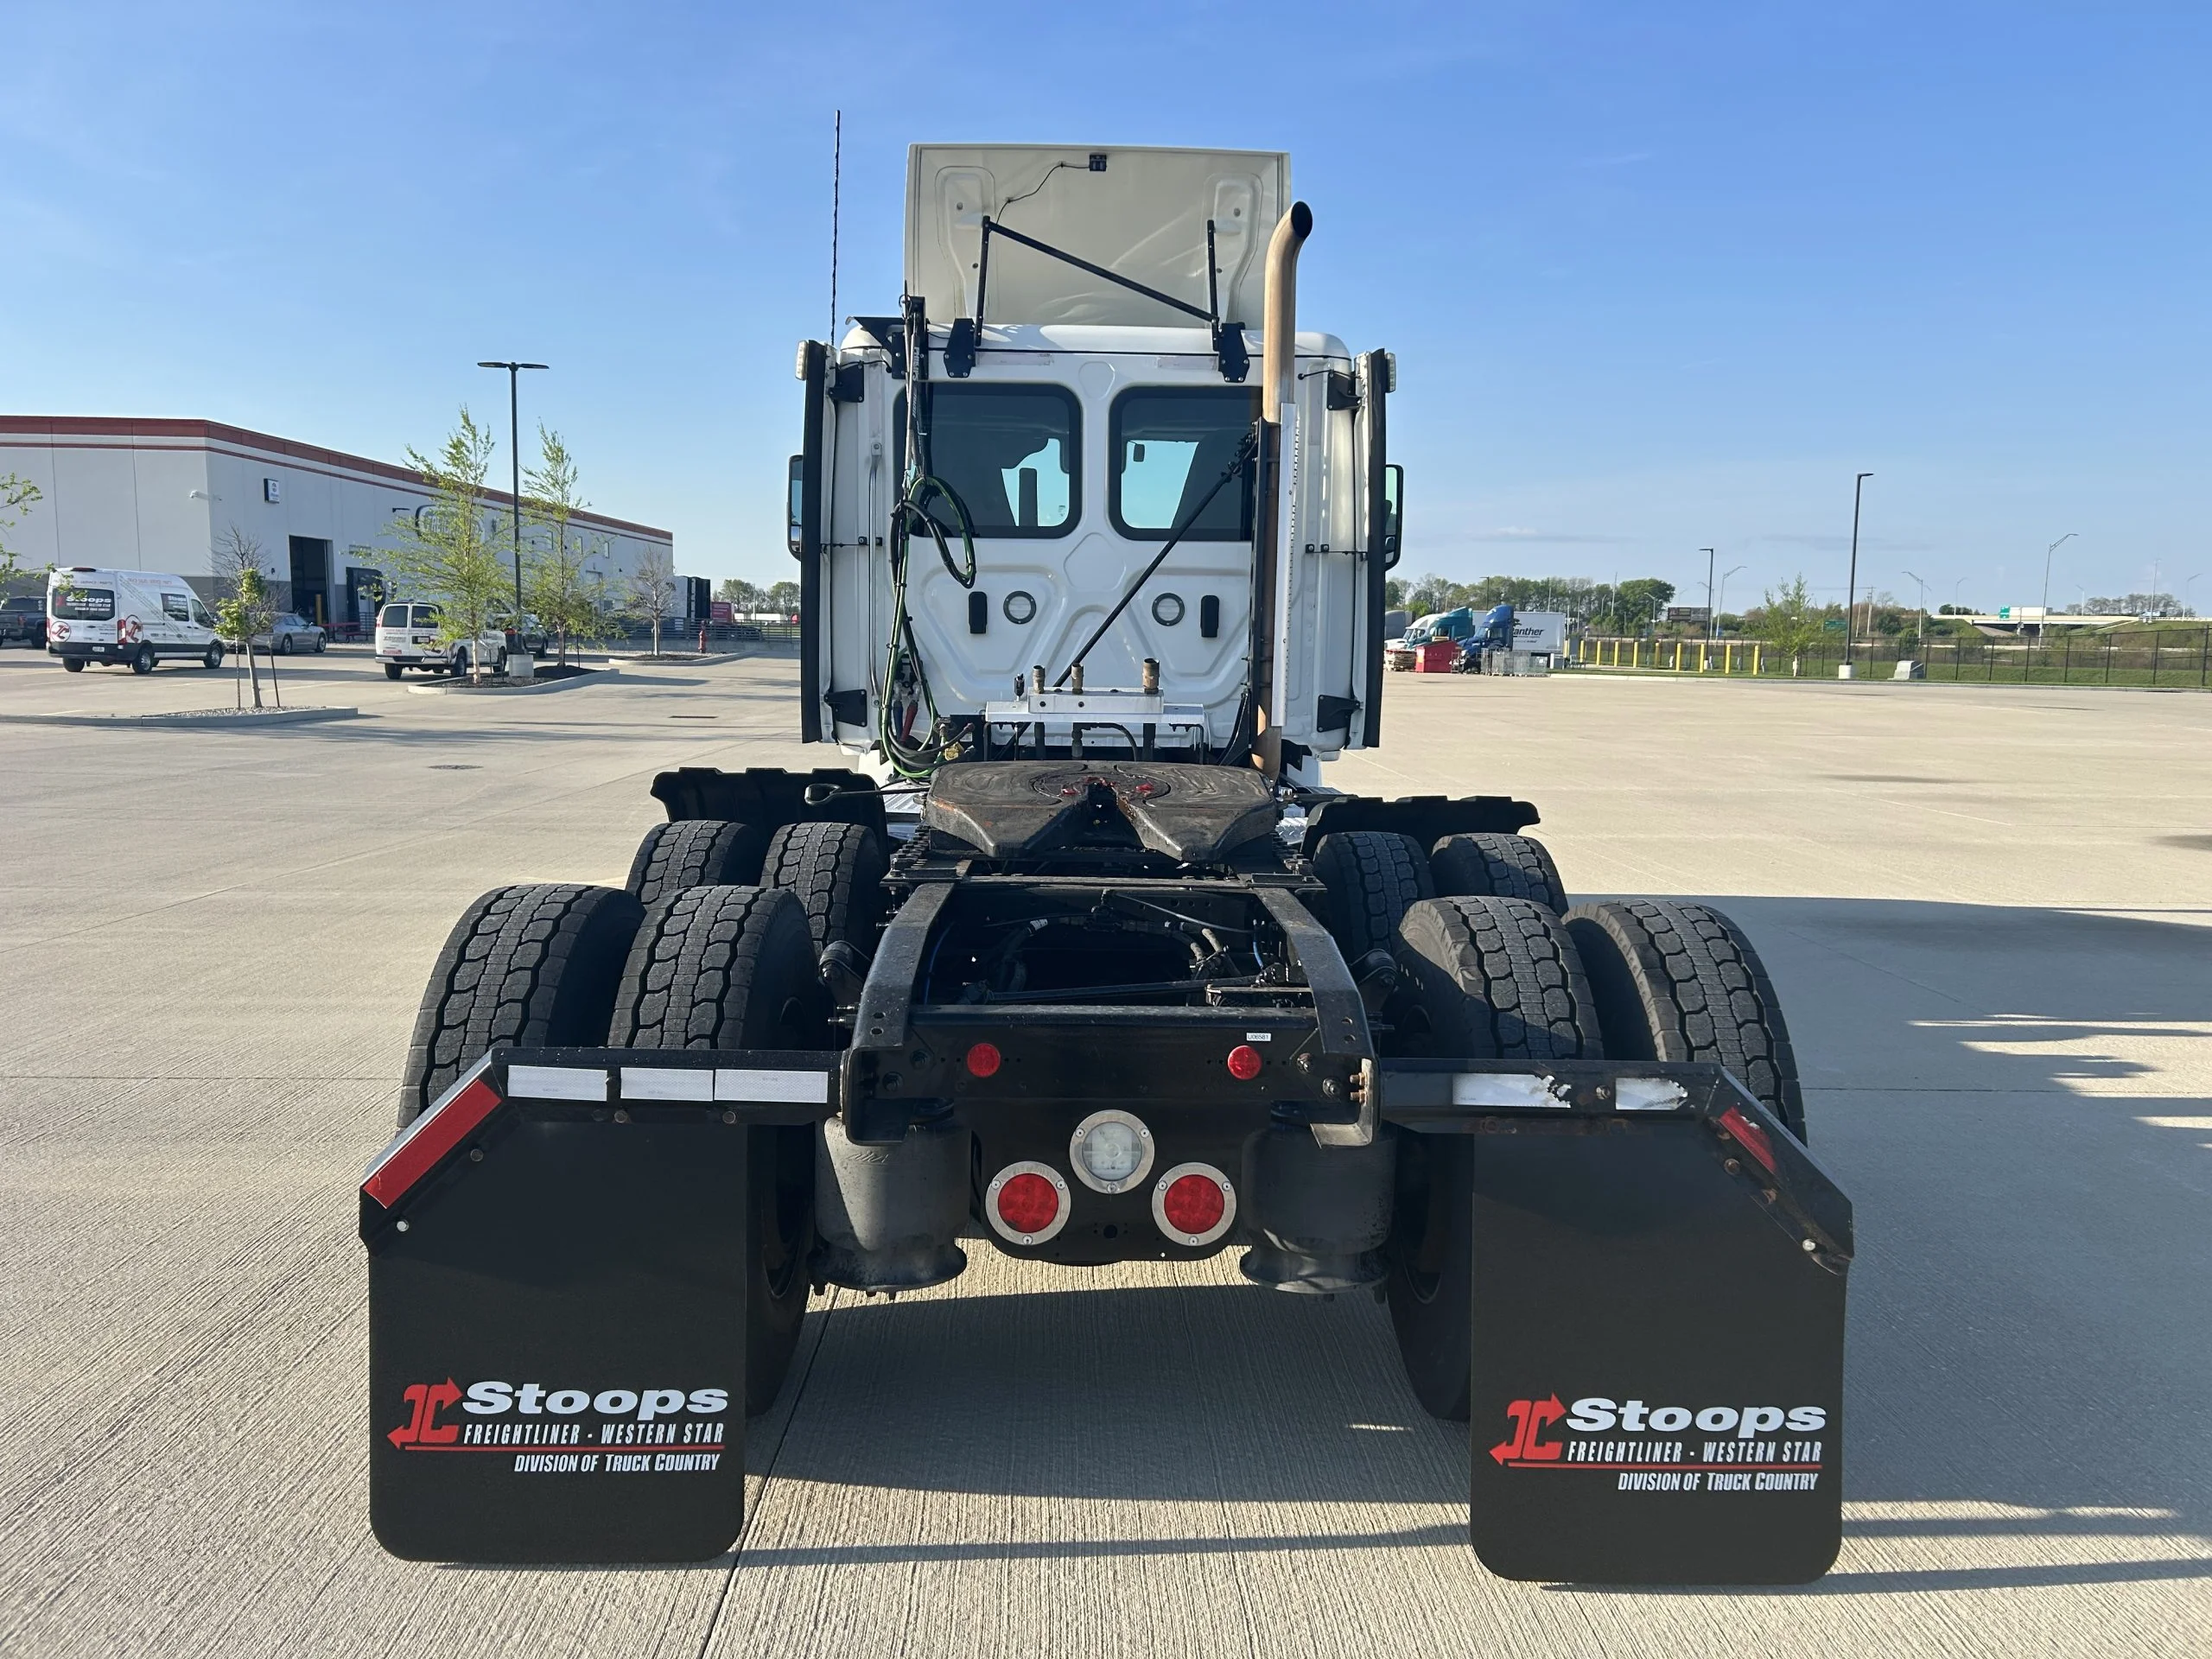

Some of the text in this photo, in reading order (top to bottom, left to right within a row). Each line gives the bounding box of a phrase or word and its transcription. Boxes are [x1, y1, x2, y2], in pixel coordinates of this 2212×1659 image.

[1512, 627, 1545, 636] anther
[462, 1381, 728, 1421] Stoops
[1566, 1397, 1827, 1439] Stoops
[463, 1424, 580, 1445] FREIGHTLINER
[601, 1424, 677, 1445] WESTERN
[683, 1422, 725, 1444] STAR
[514, 1453, 721, 1472] DIVISION OF TRUCK COUNTRY
[1567, 1441, 1682, 1463] FREIGHTLINER
[1703, 1441, 1777, 1463] WESTERN
[1783, 1440, 1822, 1463] STAR
[1618, 1471, 1819, 1491] DIVISION OF TRUCK COUNTRY
